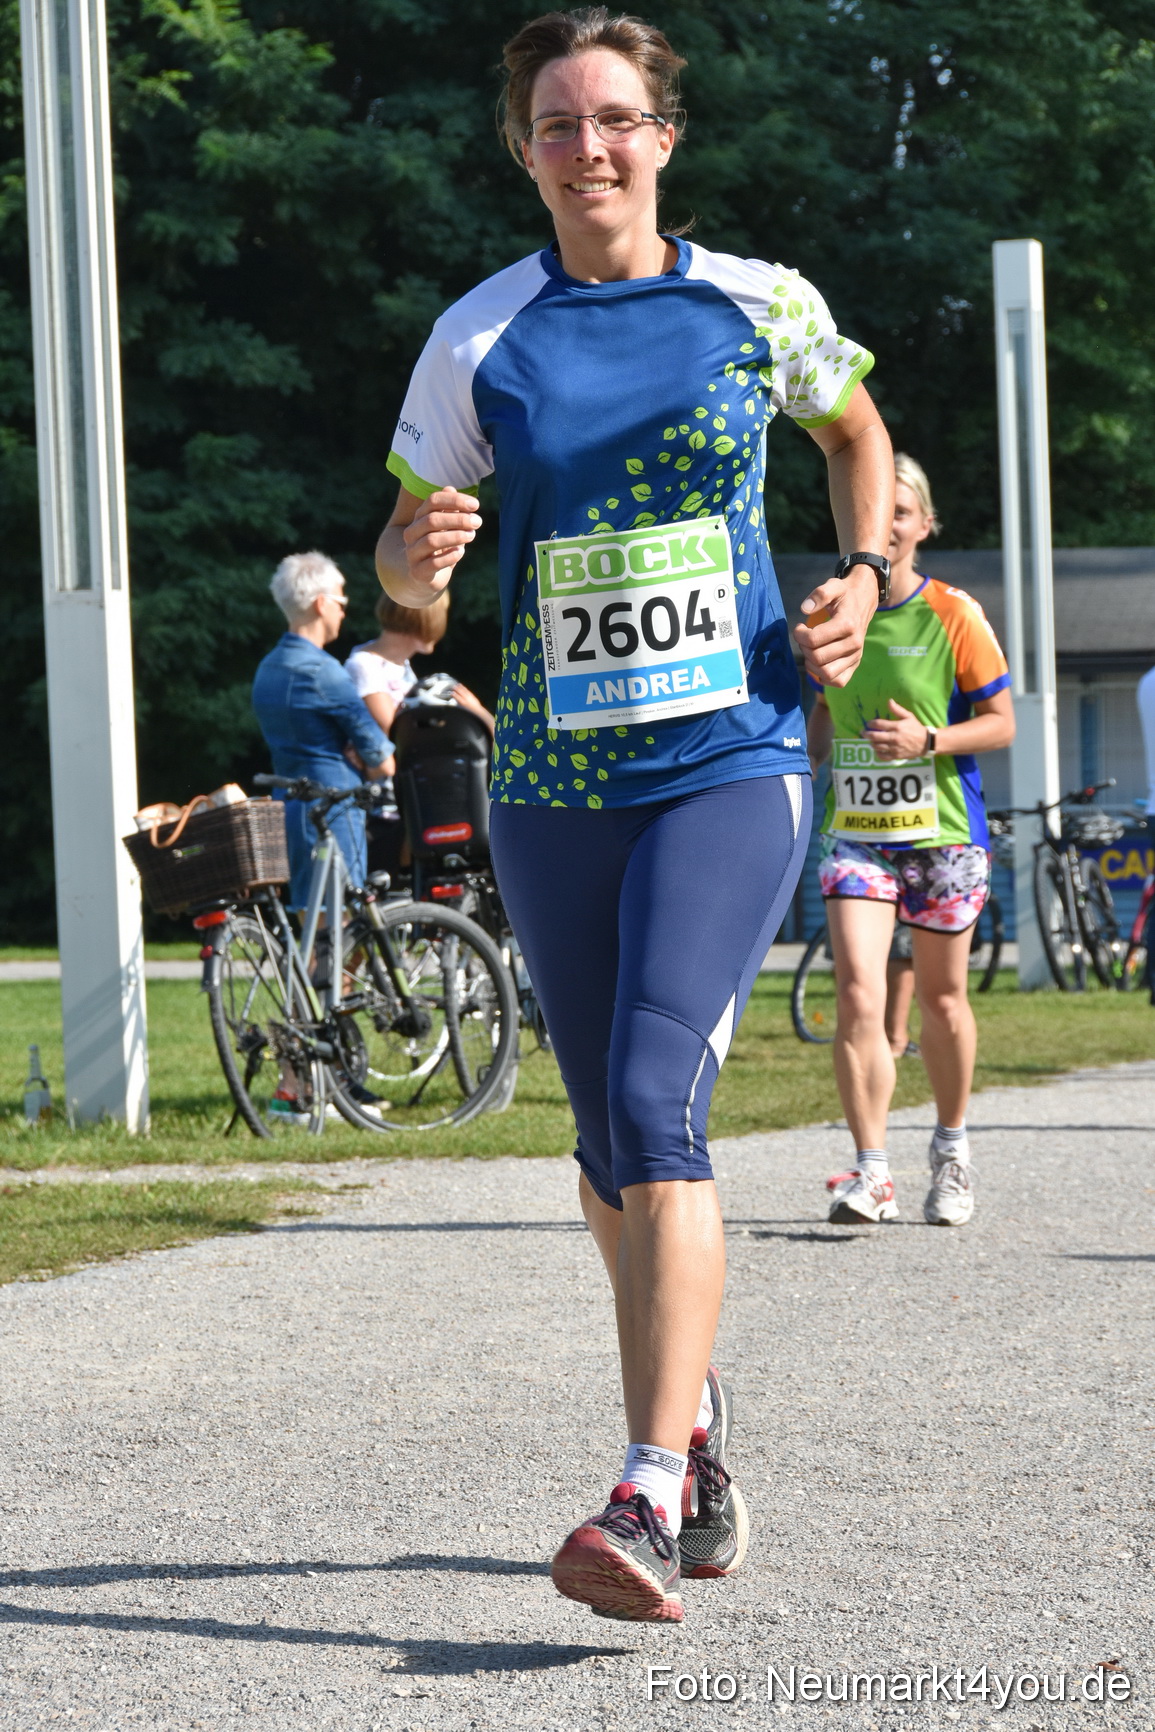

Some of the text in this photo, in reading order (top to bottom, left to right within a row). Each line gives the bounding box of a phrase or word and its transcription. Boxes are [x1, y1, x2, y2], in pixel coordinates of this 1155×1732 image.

[552, 532, 713, 587] BOCK
[718, 588, 726, 599] D
[562, 589, 716, 663] 2604
[888, 646, 928, 656] BOCK
[586, 665, 711, 705] ANDREA
[844, 774, 922, 806] 1280
[844, 814, 924, 829] MICHAELA
[658, 1455, 684, 1470] SOCKS
